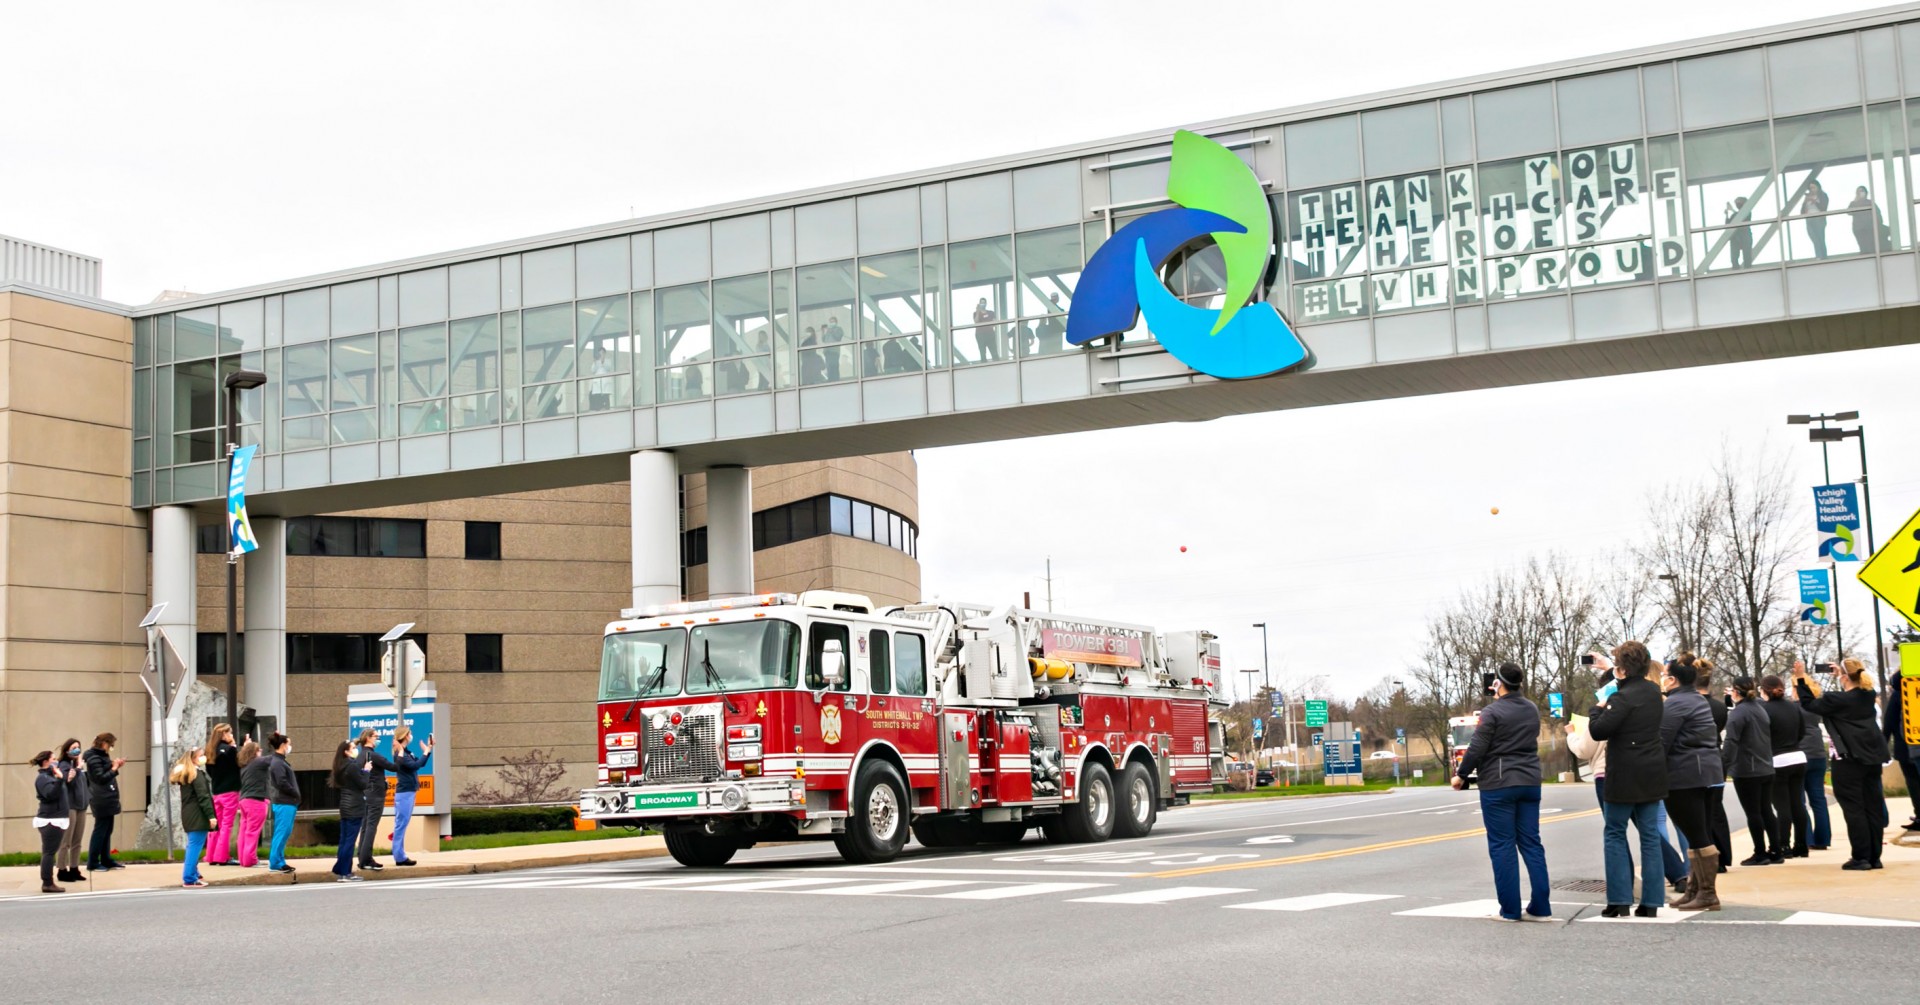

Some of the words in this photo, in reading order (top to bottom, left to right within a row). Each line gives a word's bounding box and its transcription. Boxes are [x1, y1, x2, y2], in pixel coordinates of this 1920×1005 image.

[1301, 172, 1468, 220] THANK
[1529, 148, 1634, 186] YOU
[1376, 211, 1598, 267] HEROES
[1304, 241, 1684, 313] #LVHNPROUD
[1817, 488, 1846, 497] Lehigh
[1818, 497, 1845, 505] Valley
[1819, 505, 1848, 513] Health
[1820, 513, 1857, 522] Network
[1053, 632, 1106, 652] TOWER
[865, 710, 883, 719] SOUTH
[883, 711, 911, 720] WHITEHALL
[359, 718, 385, 728] Hospital
[386, 718, 414, 727] Entrnce
[872, 721, 900, 729] DISTRICTS
[640, 796, 693, 805] BROADWAY
